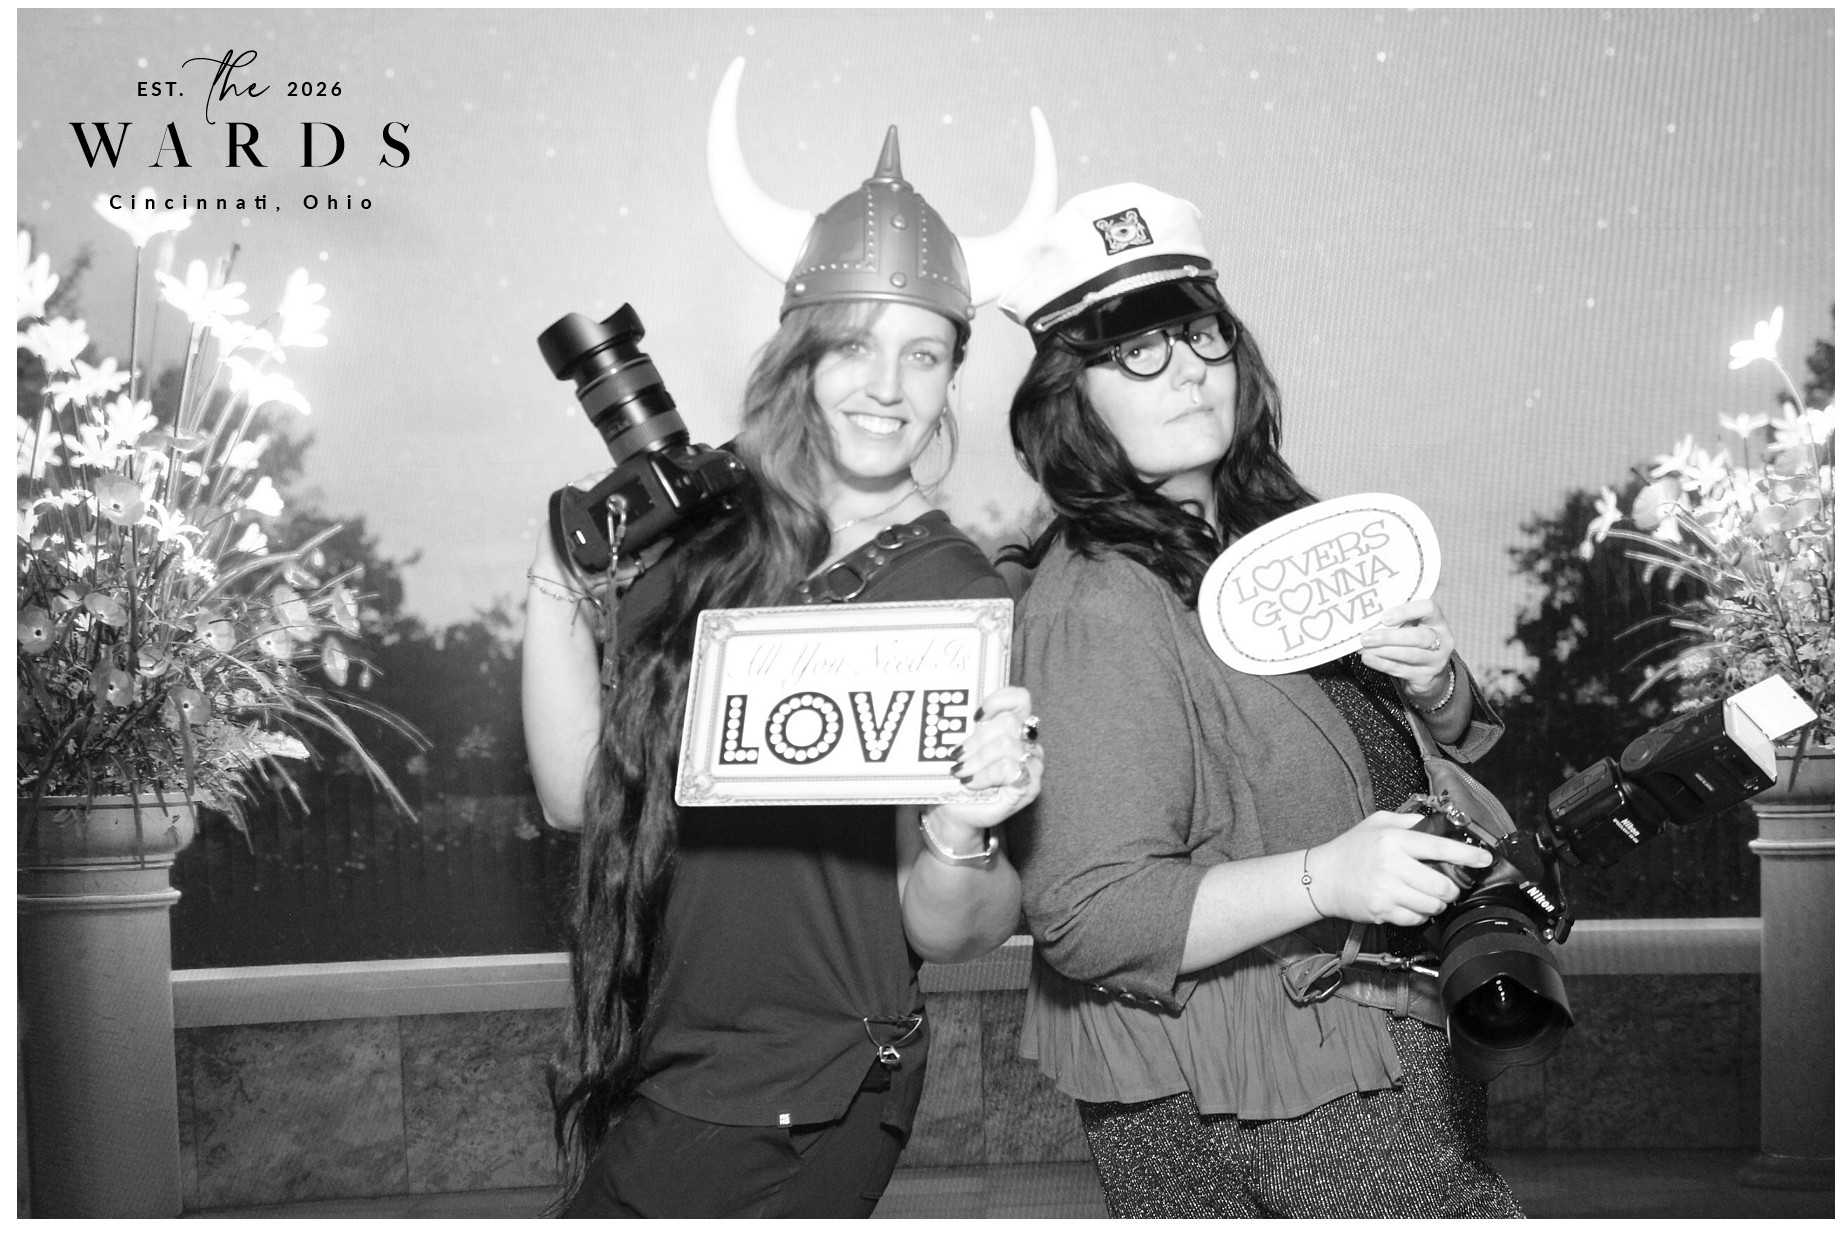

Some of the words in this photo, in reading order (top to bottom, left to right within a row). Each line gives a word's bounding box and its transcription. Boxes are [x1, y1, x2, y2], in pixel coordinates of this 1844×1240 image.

[1231, 519, 1390, 605] LOVERS
[1252, 554, 1400, 627] GONNA
[1277, 588, 1384, 653] LOVE
[780, 641, 848, 691] You
[718, 689, 970, 766] LOVE
[1620, 817, 1640, 837] Nikon
[1526, 886, 1555, 912] Nikon
